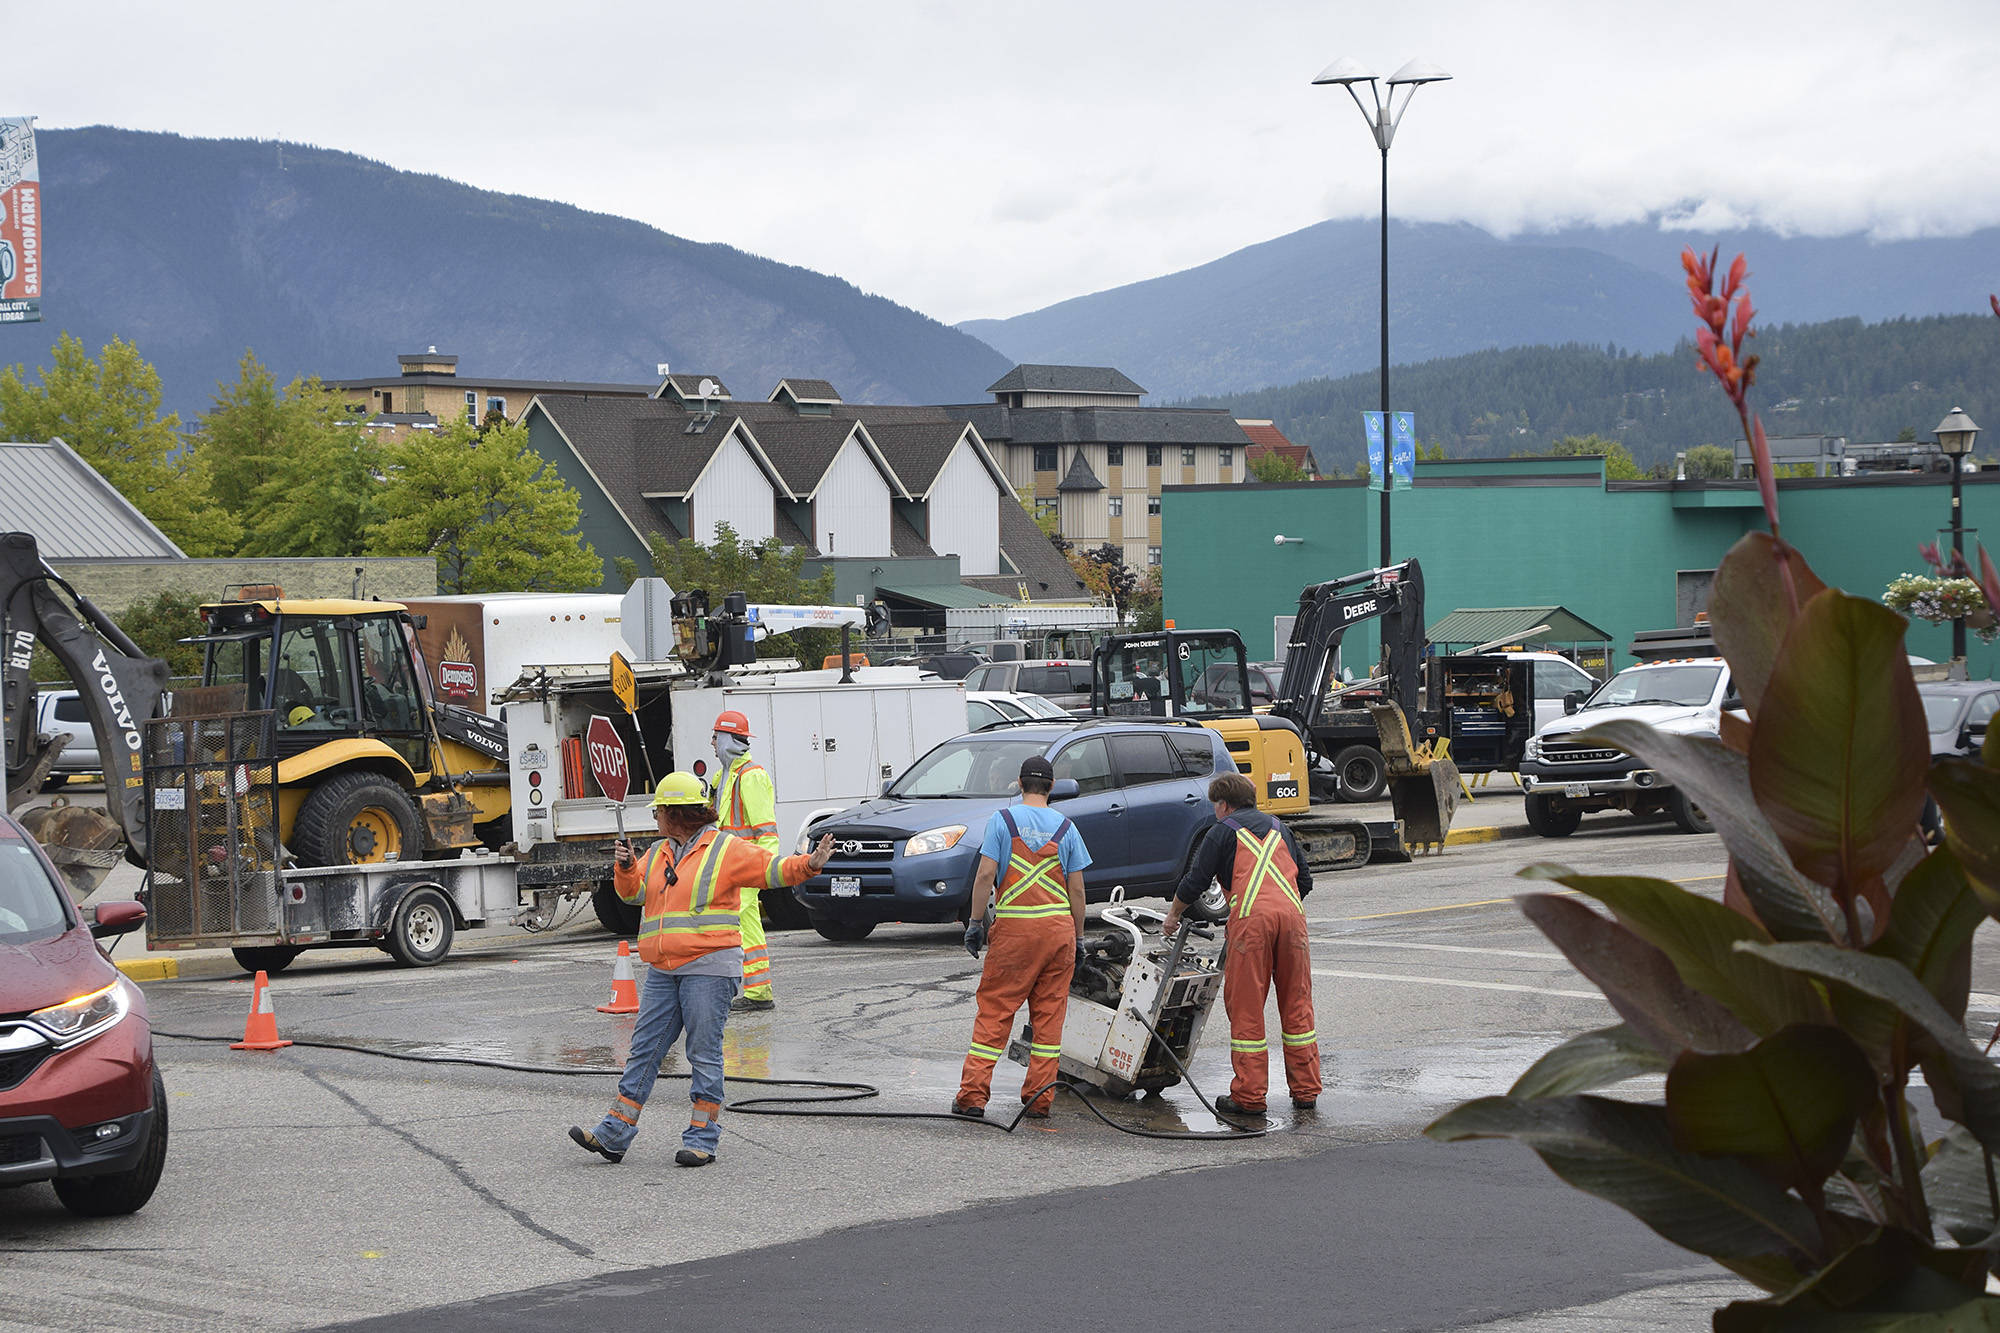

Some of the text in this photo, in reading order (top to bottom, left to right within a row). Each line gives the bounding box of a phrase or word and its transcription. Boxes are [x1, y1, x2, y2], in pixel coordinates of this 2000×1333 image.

[0, 302, 11, 311] ALL
[3, 311, 24, 321] IDEAS
[1343, 599, 1377, 620] DEERE
[10, 630, 35, 670] BL70
[1123, 640, 1160, 649] JOHN DEERE
[441, 666, 475, 688] Dempster's
[614, 671, 633, 695] SLOW
[92, 649, 142, 750] VOLVO
[466, 729, 503, 752] VOLVO
[590, 741, 624, 778] STOP
[1548, 752, 1613, 760] STERLING
[1276, 787, 1297, 798] 60G
[1108, 1046, 1134, 1064] CORE
[1112, 1058, 1132, 1073] CUT
